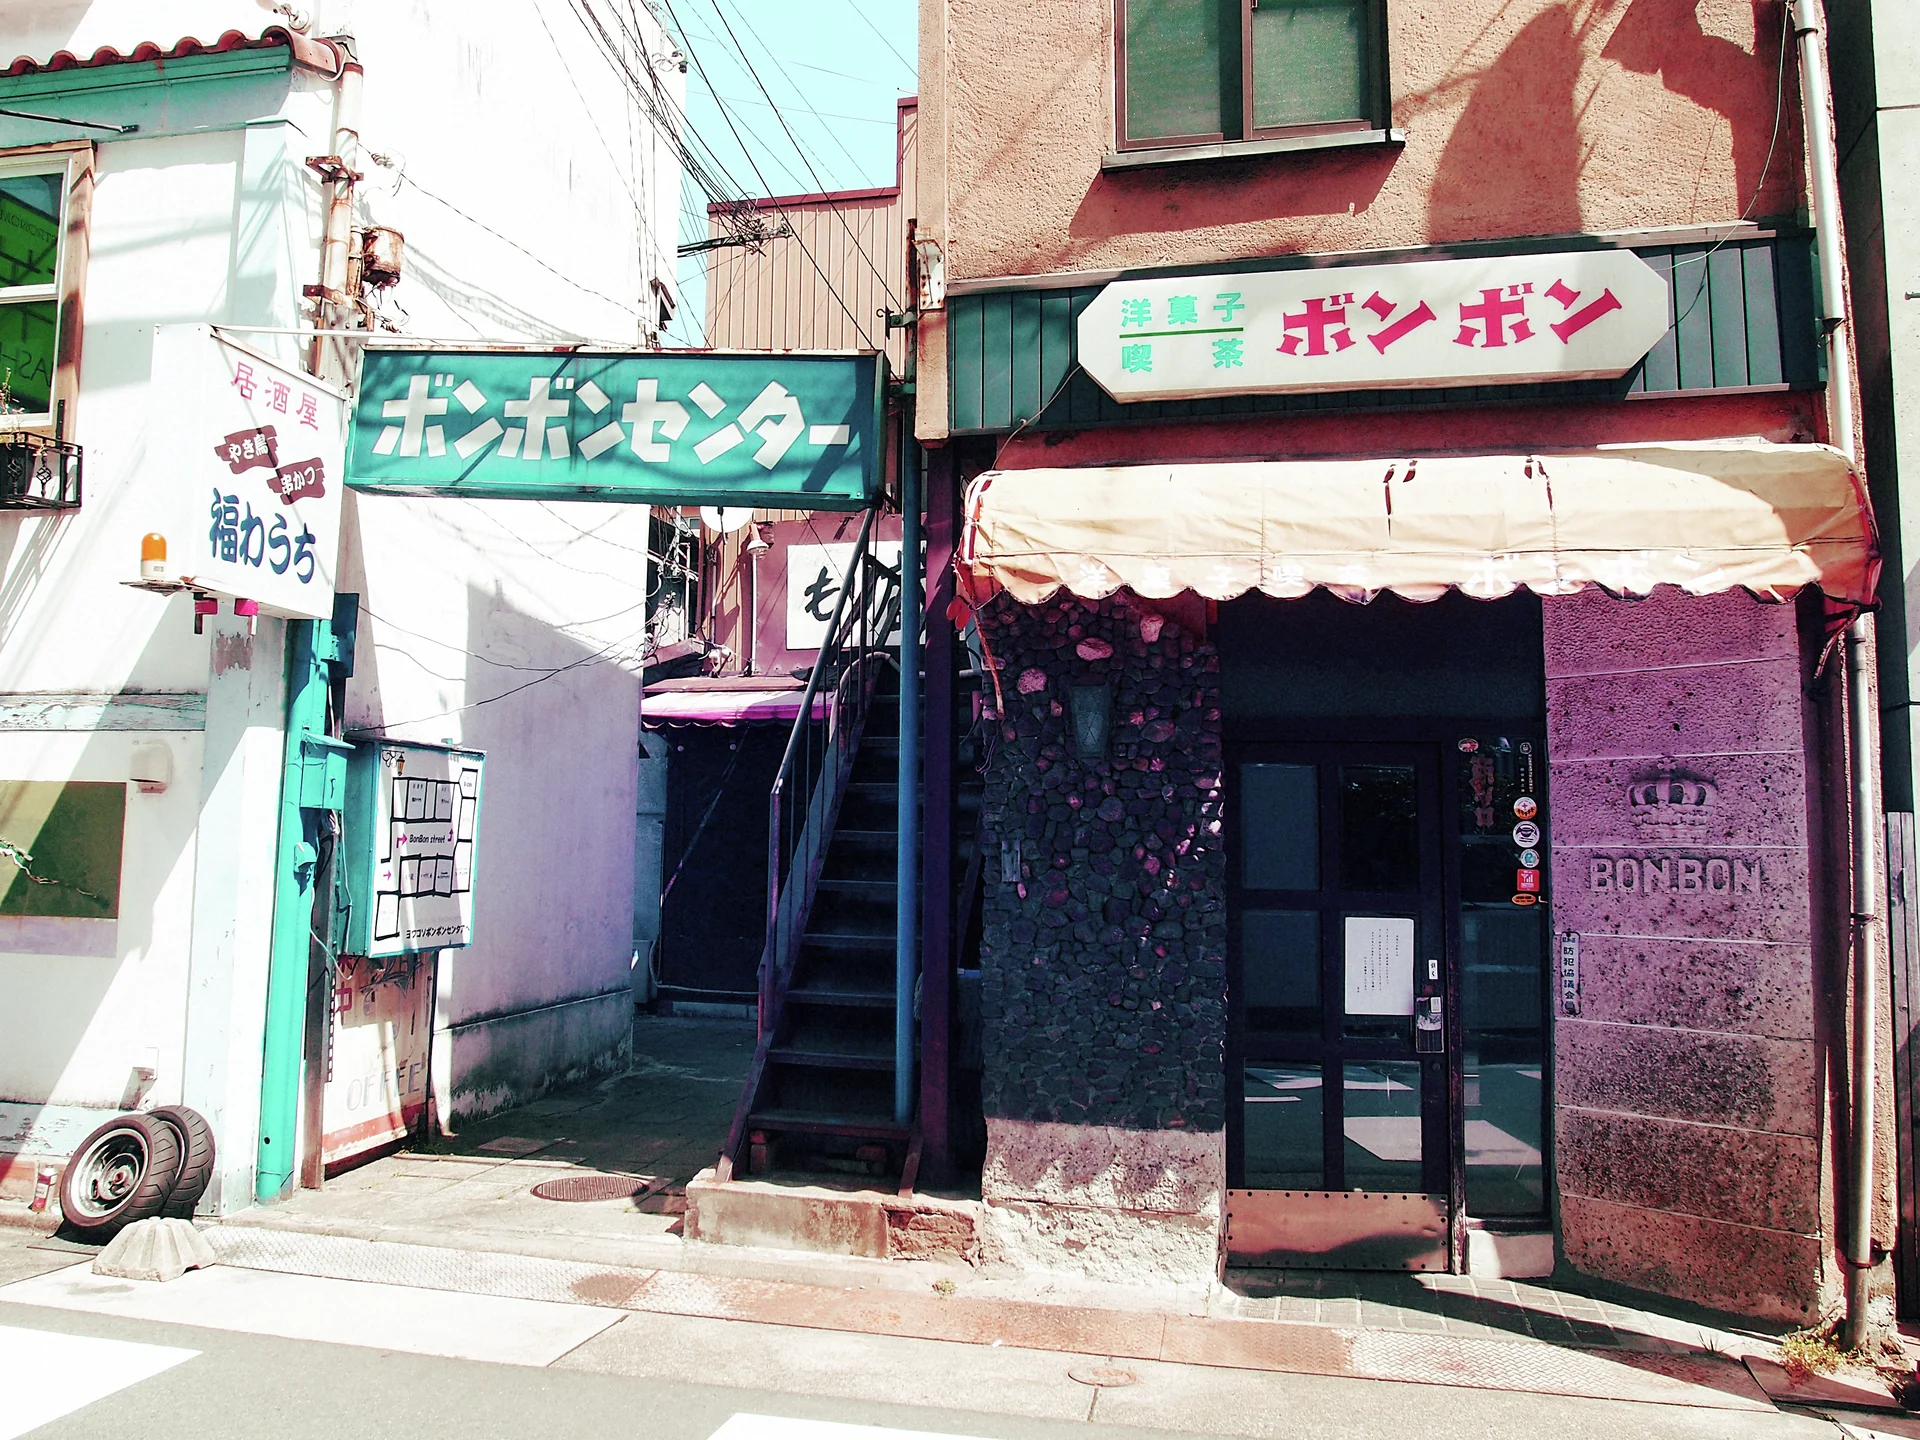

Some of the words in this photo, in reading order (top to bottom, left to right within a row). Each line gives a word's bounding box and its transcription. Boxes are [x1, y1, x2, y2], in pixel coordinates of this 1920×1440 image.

[1121, 291, 1245, 328] 洋菓子
[1276, 278, 1623, 356] ボンボン
[1121, 337, 1244, 373] 喫茶
[230, 361, 319, 431] 居酒屋
[371, 373, 850, 470] ボンボンセンター
[228, 433, 269, 464] やき鳥
[279, 465, 317, 496] 串かつ
[409, 834, 429, 843] BonBon
[430, 834, 446, 844] street
